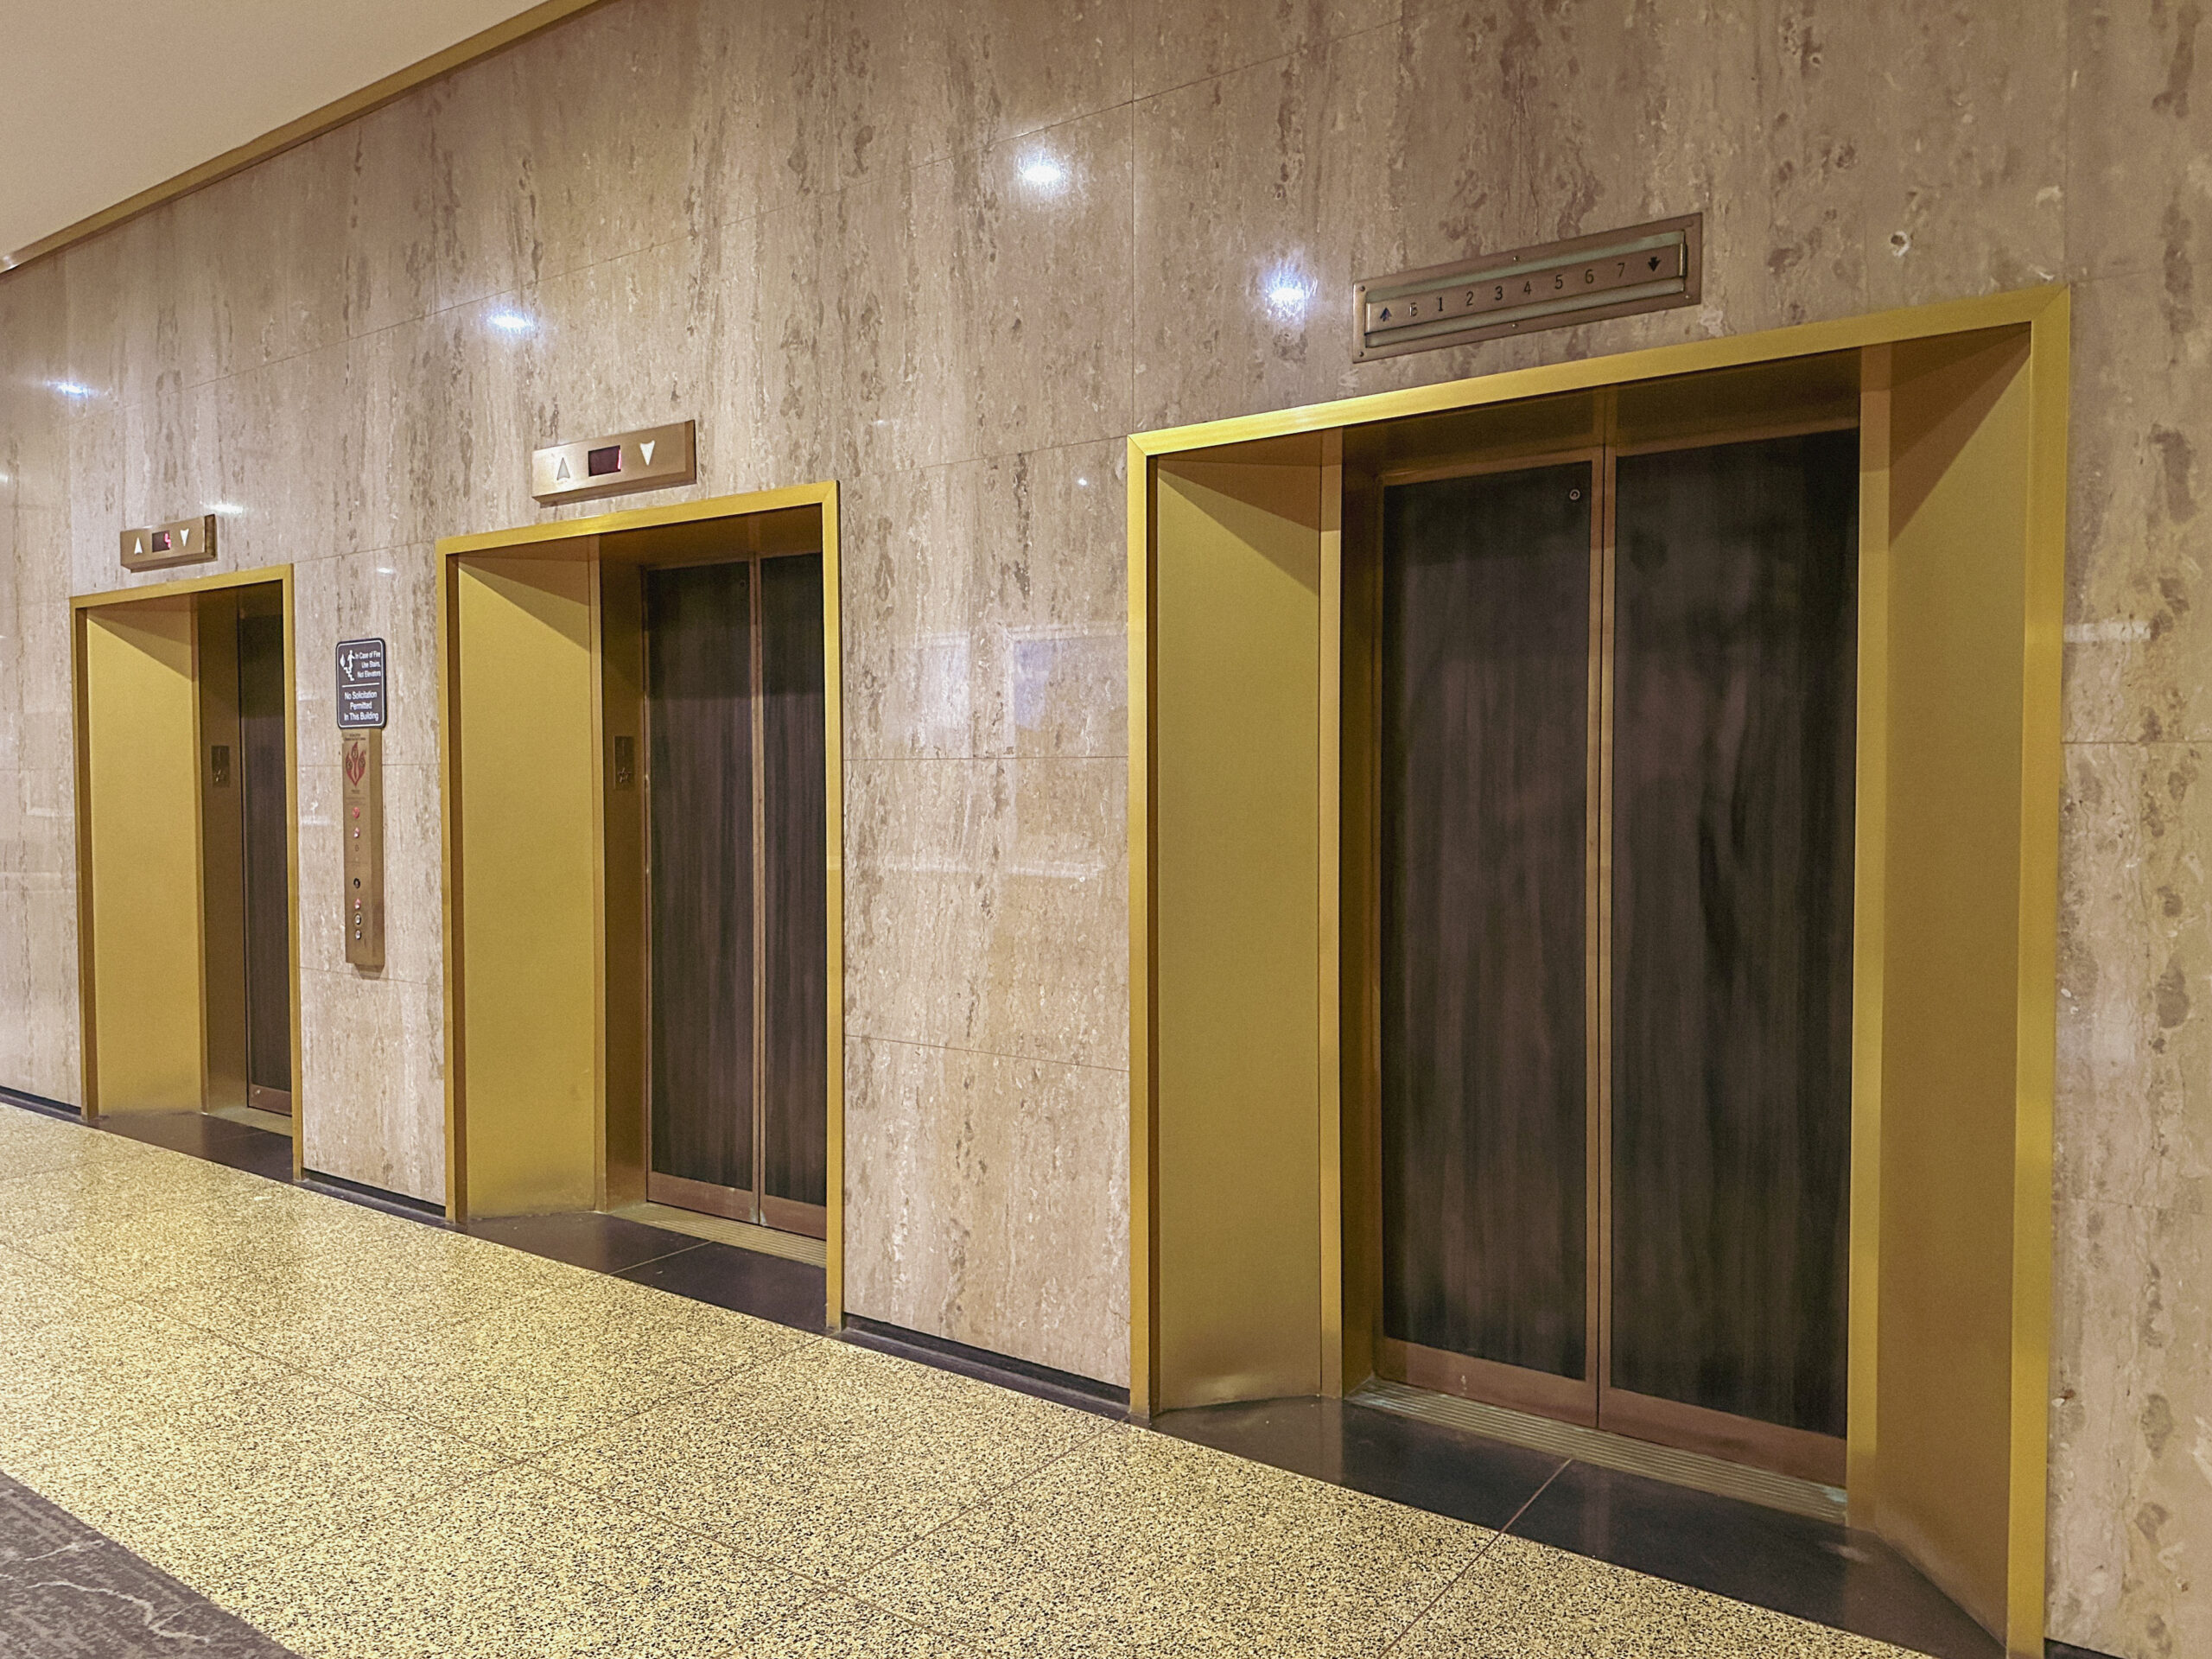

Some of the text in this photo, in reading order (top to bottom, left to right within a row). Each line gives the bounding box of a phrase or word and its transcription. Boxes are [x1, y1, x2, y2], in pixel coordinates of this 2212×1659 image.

[1437, 296, 1444, 312] 1
[1465, 290, 1474, 307] 2
[1494, 285, 1503, 301] 3
[1523, 281, 1532, 295] 4
[1554, 274, 1563, 289] 5
[1585, 269, 1594, 284] 6
[1617, 262, 1625, 278] 7
[344, 690, 378, 700] No Solicitation
[349, 701, 372, 710] Permitted
[349, 712, 359, 721] This
[359, 711, 379, 721] Building
